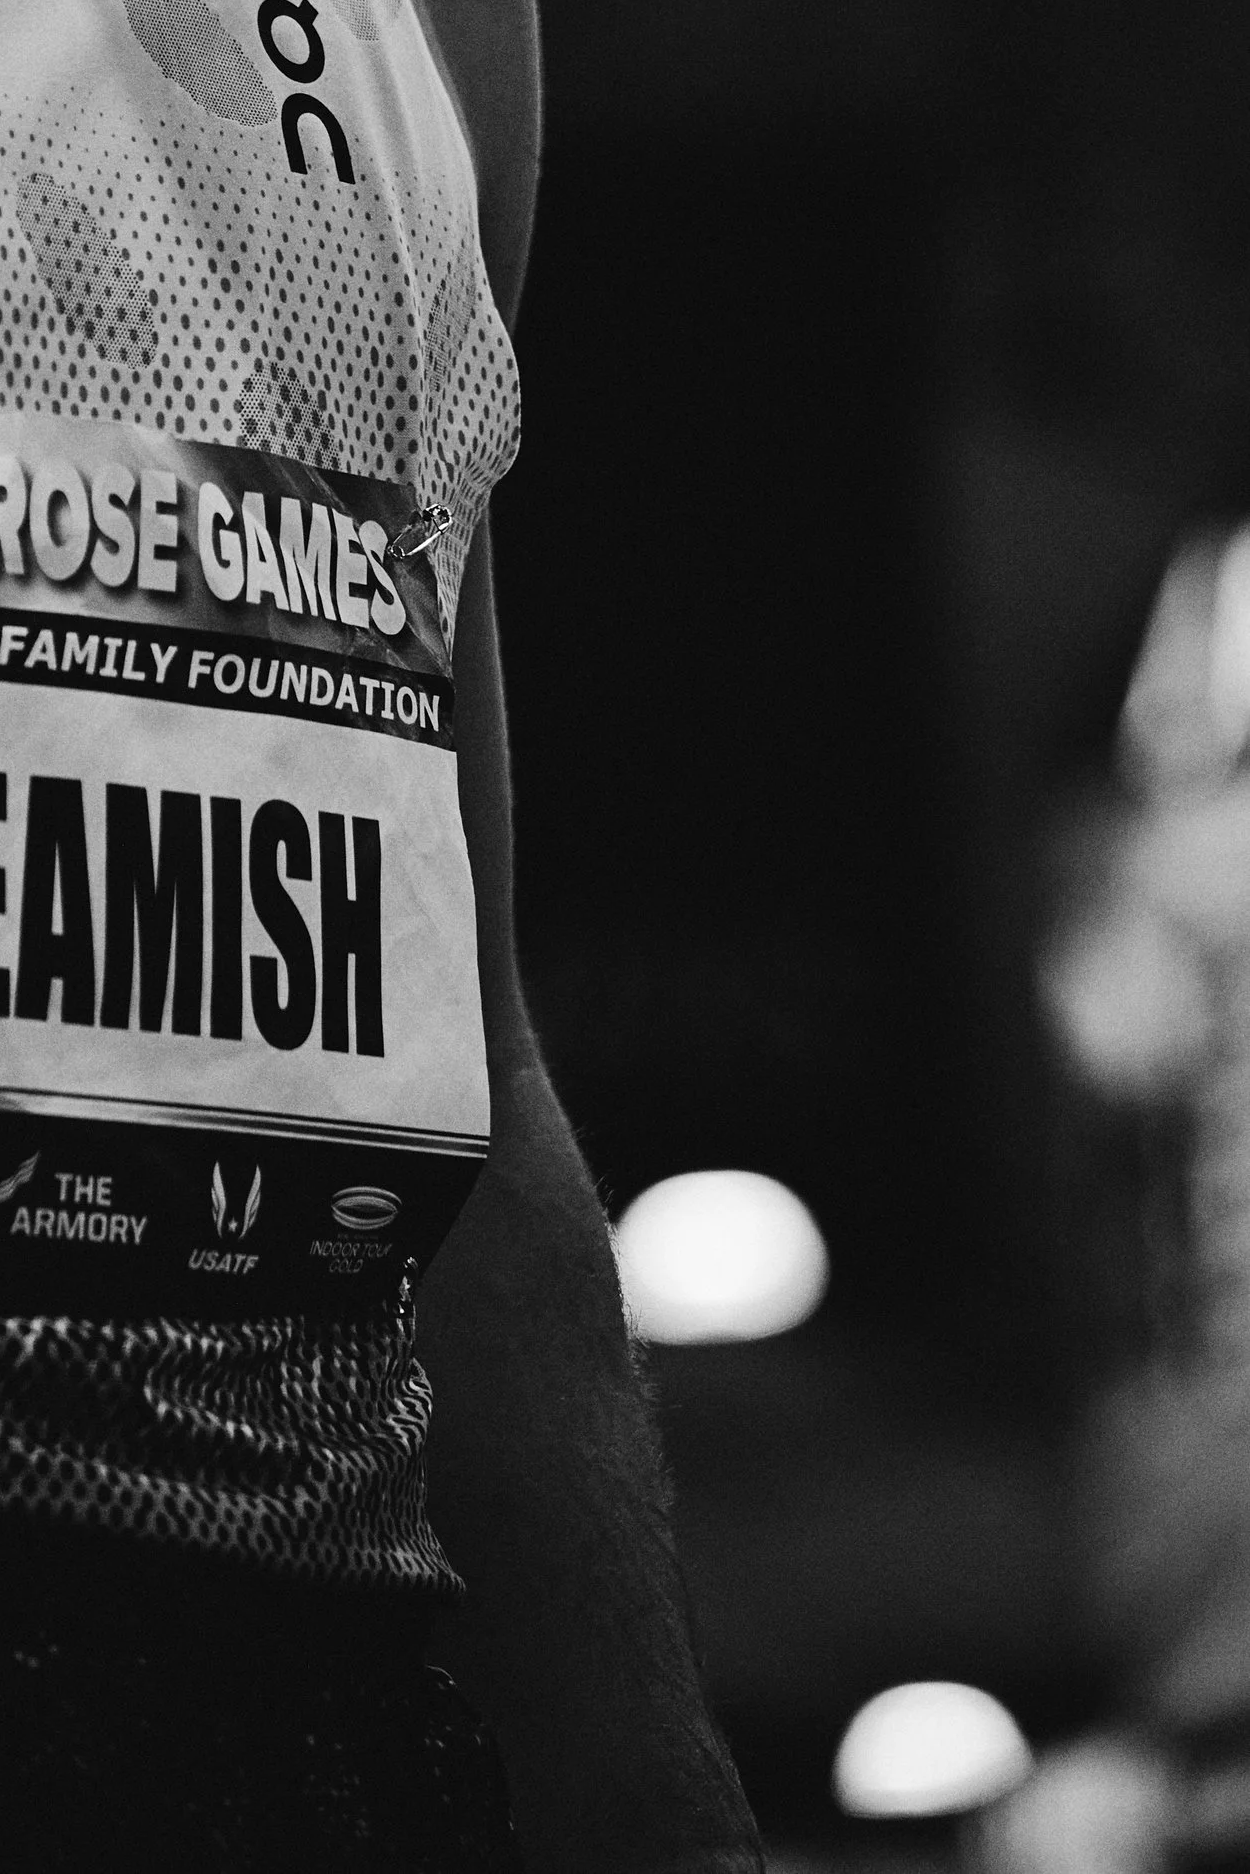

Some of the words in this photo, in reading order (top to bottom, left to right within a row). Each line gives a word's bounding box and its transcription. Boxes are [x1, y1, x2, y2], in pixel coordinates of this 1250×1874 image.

[198, 480, 407, 636] GAMES
[187, 650, 441, 733] FOUNDATION
[55, 1172, 112, 1206] THE
[10, 1207, 148, 1245] ARMORY
[188, 1248, 259, 1276] USATF
[309, 1240, 361, 1258] INDOOR
[329, 1258, 364, 1274] GOLD
